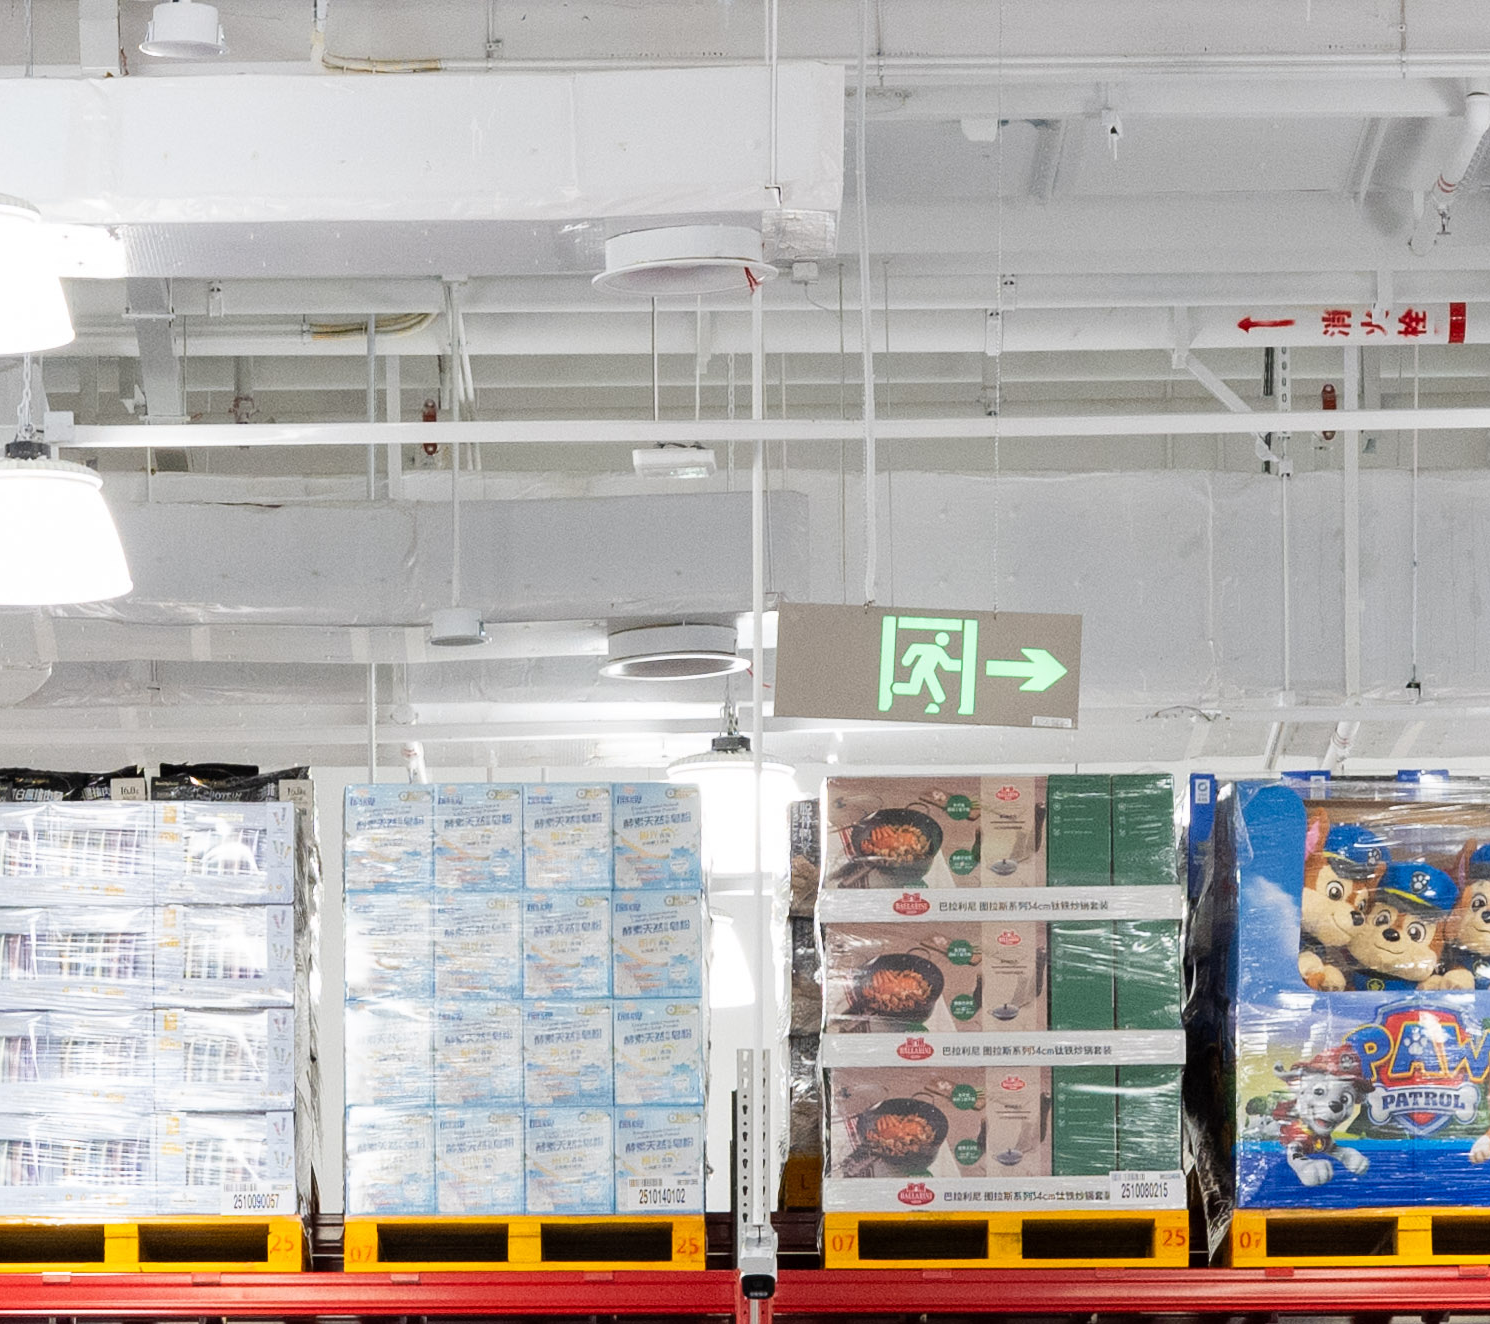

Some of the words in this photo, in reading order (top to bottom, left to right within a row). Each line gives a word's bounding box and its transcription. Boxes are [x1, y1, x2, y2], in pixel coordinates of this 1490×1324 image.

[939, 901, 976, 911] 巴拉利尼
[1382, 1091, 1465, 1110] PATROL
[638, 1189, 686, 1205] 2510140102
[1120, 1182, 1169, 1198] 2510080215
[1162, 1228, 1186, 1246] 25
